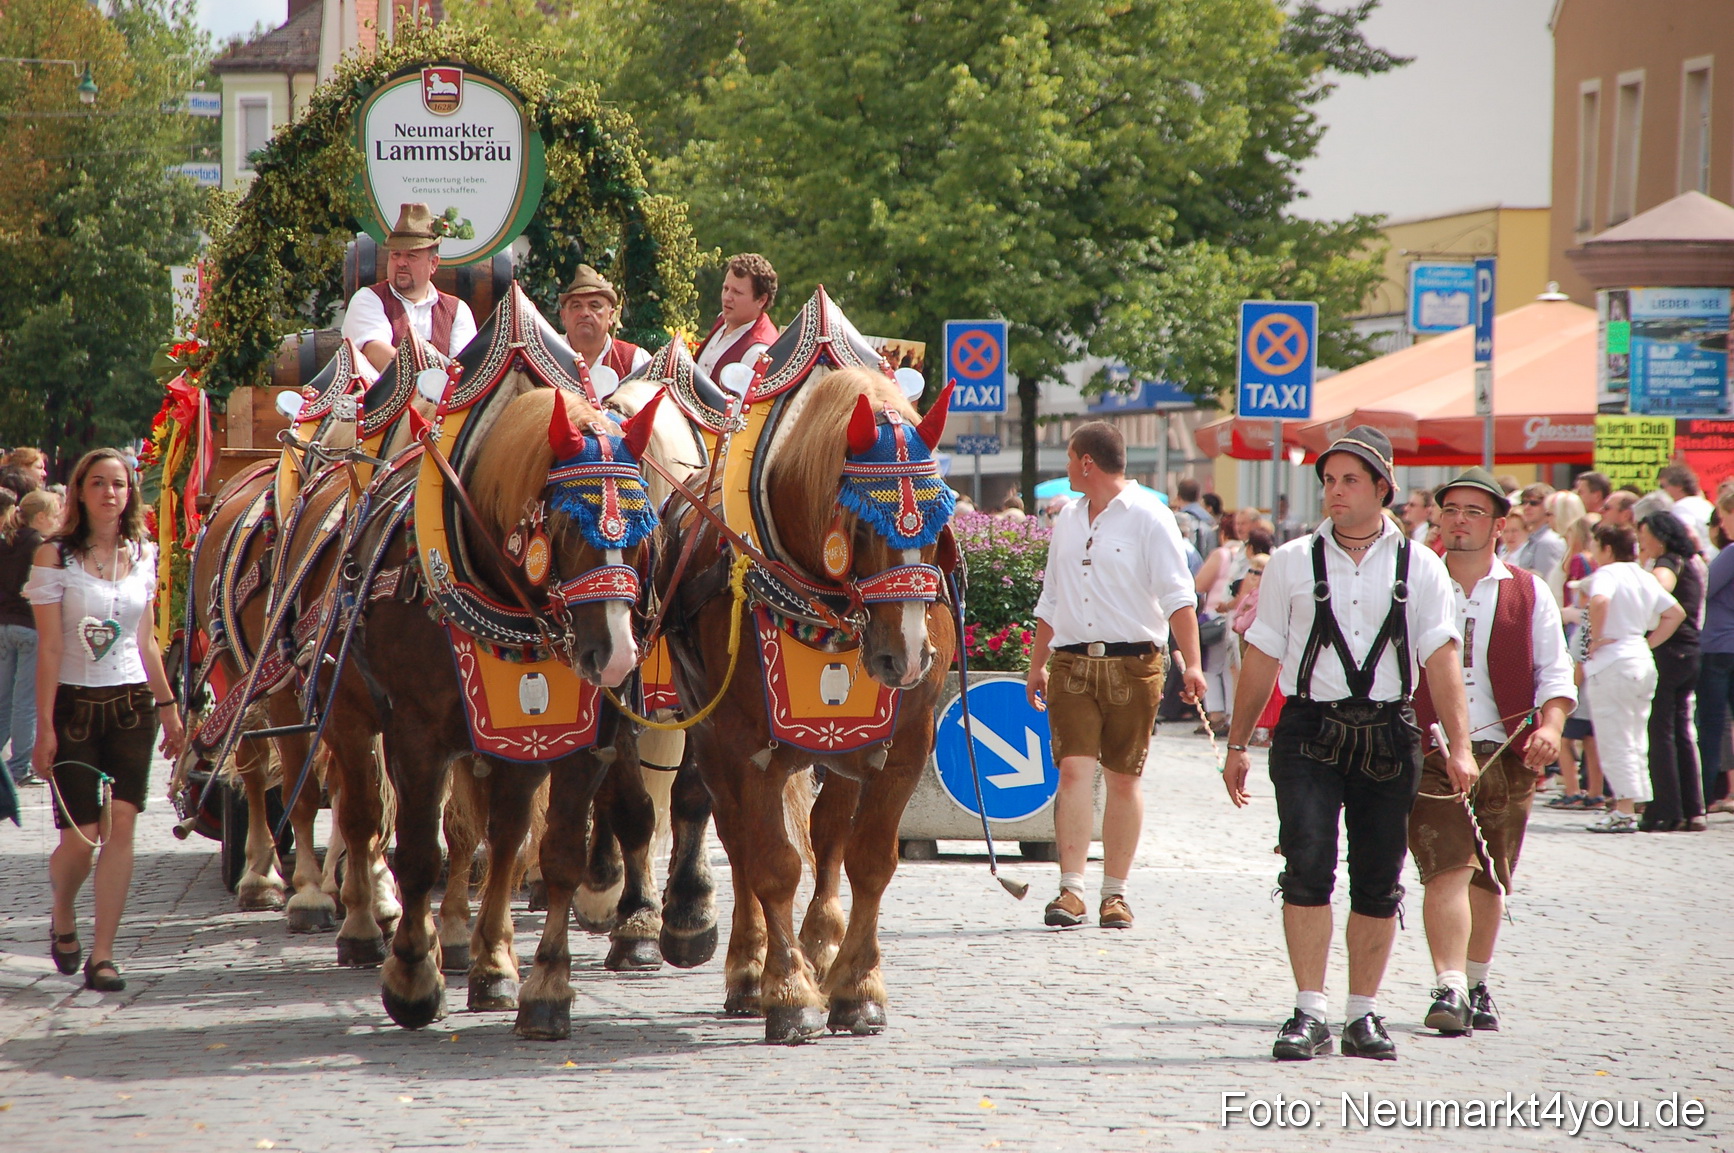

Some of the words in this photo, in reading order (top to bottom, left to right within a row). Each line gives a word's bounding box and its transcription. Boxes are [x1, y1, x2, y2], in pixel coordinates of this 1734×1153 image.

[434, 103, 452, 111] 1628
[394, 123, 494, 138] Neumarkter
[375, 140, 512, 161] Lammsbräu
[402, 176, 461, 185] Verantwortung
[463, 176, 487, 184] leben.
[412, 186, 441, 194] Genuss
[442, 186, 478, 194] schaffen.
[1478, 268, 1492, 328] P
[1652, 299, 1690, 310] LIEDER
[1702, 299, 1722, 309] SEE
[954, 385, 1000, 406] TAXI
[1244, 383, 1307, 410] TAXI
